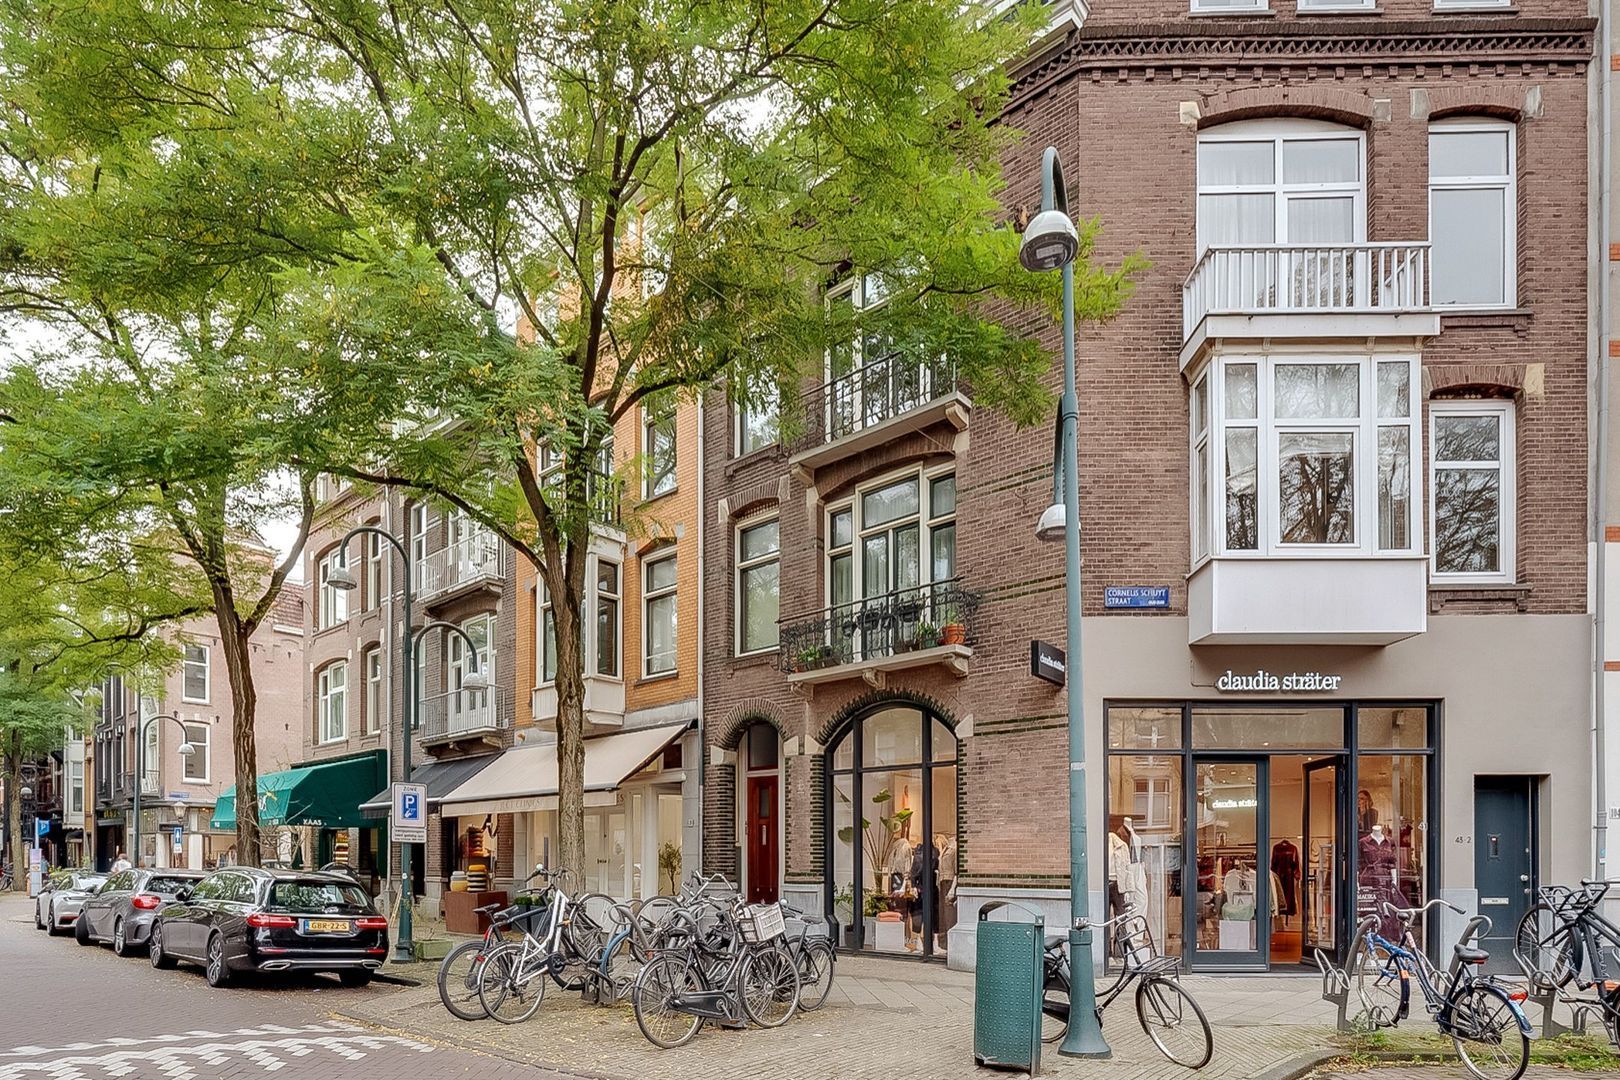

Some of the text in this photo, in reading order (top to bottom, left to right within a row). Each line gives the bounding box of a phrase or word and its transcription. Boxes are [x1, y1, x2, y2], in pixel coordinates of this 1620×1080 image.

[1108, 589, 1166, 597] CORNELIS SCHUYT
[1108, 597, 1131, 605] STRAAT
[1218, 670, 1341, 690] claudia sträter
[405, 795, 414, 808] P
